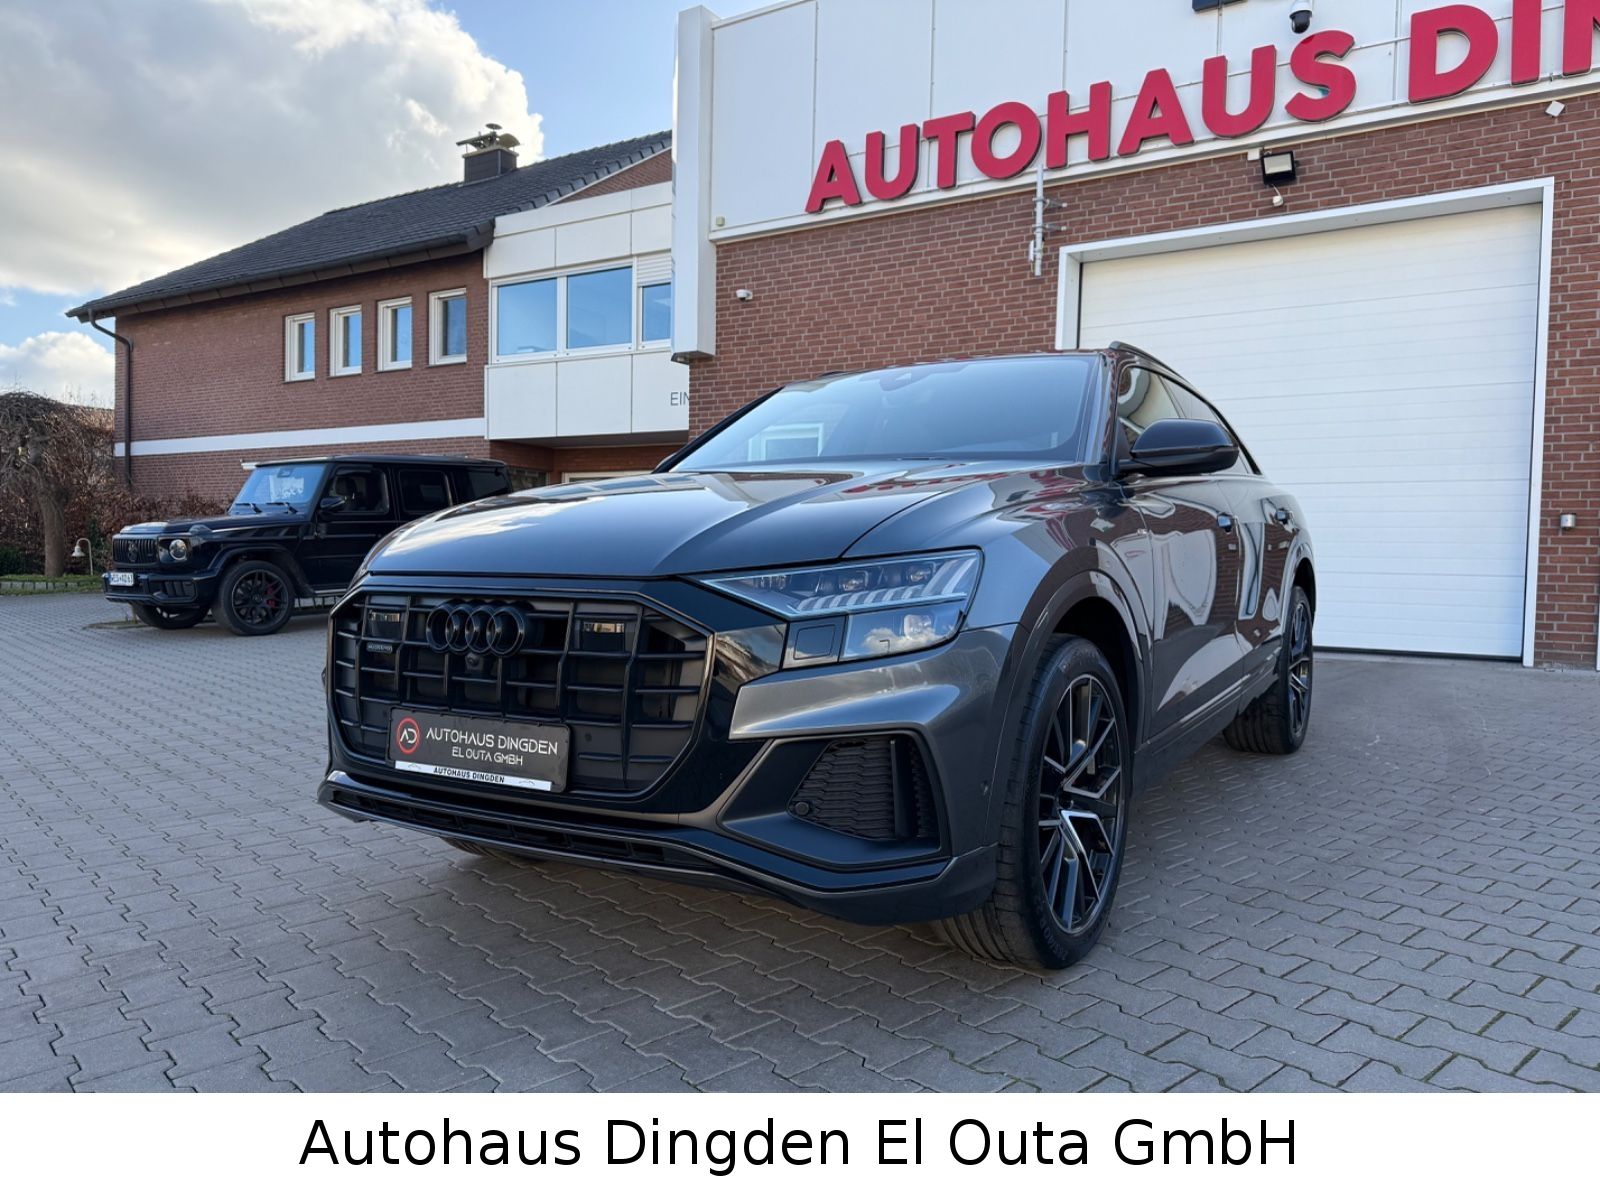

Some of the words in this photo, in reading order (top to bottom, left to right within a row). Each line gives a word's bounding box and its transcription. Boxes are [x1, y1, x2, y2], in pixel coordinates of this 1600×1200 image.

[807, 31, 1356, 213] AUTOHAUS
[426, 727, 495, 748] AUTOHAUS
[497, 735, 558, 756] DINGDEN
[452, 746, 465, 758] EL
[465, 748, 492, 762] OUTA
[433, 766, 470, 778] AUTOHAUS
[472, 772, 505, 784] DINGDEN
